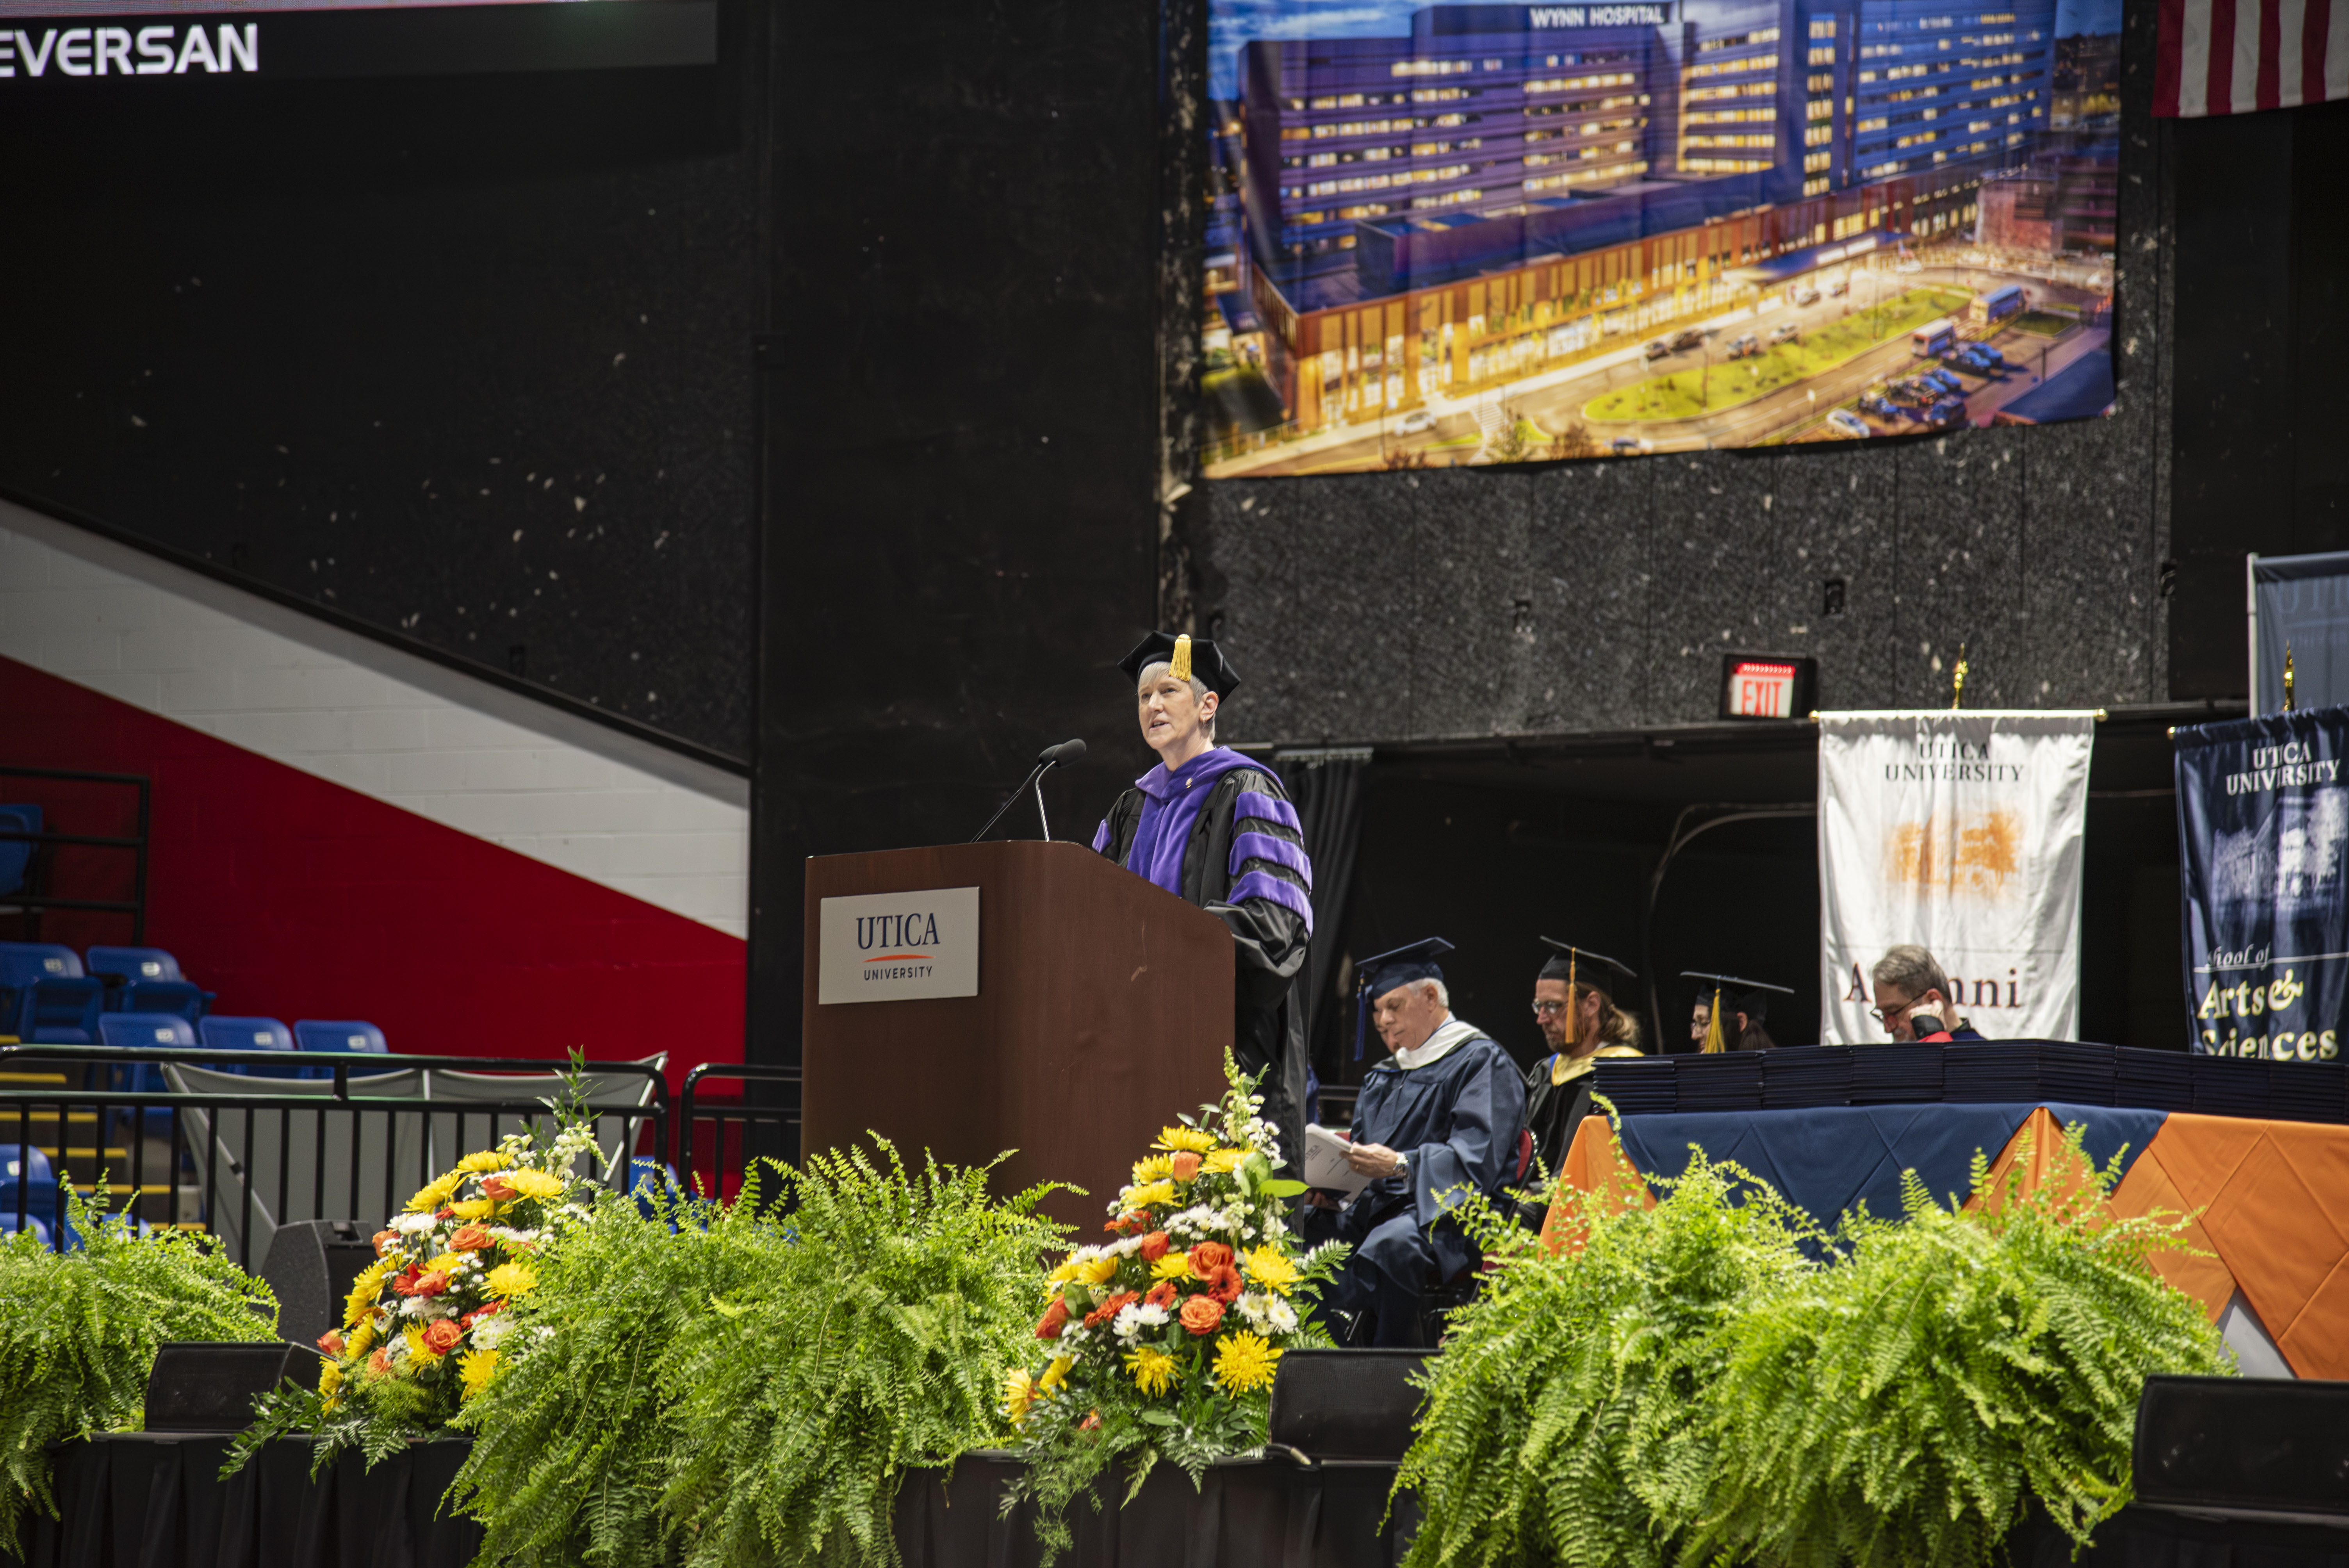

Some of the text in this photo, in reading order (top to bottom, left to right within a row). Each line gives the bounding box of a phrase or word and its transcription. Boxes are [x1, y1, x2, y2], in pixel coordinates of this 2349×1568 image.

[1529, 5, 1665, 29] WYNN HOSPITAL
[1741, 679, 1783, 718] EXIT
[1919, 742, 1990, 760] UTICA
[1885, 763, 2024, 782] UNIVERSITY
[855, 912, 941, 950] UTICA
[864, 966, 933, 981] UNIVERSITY
